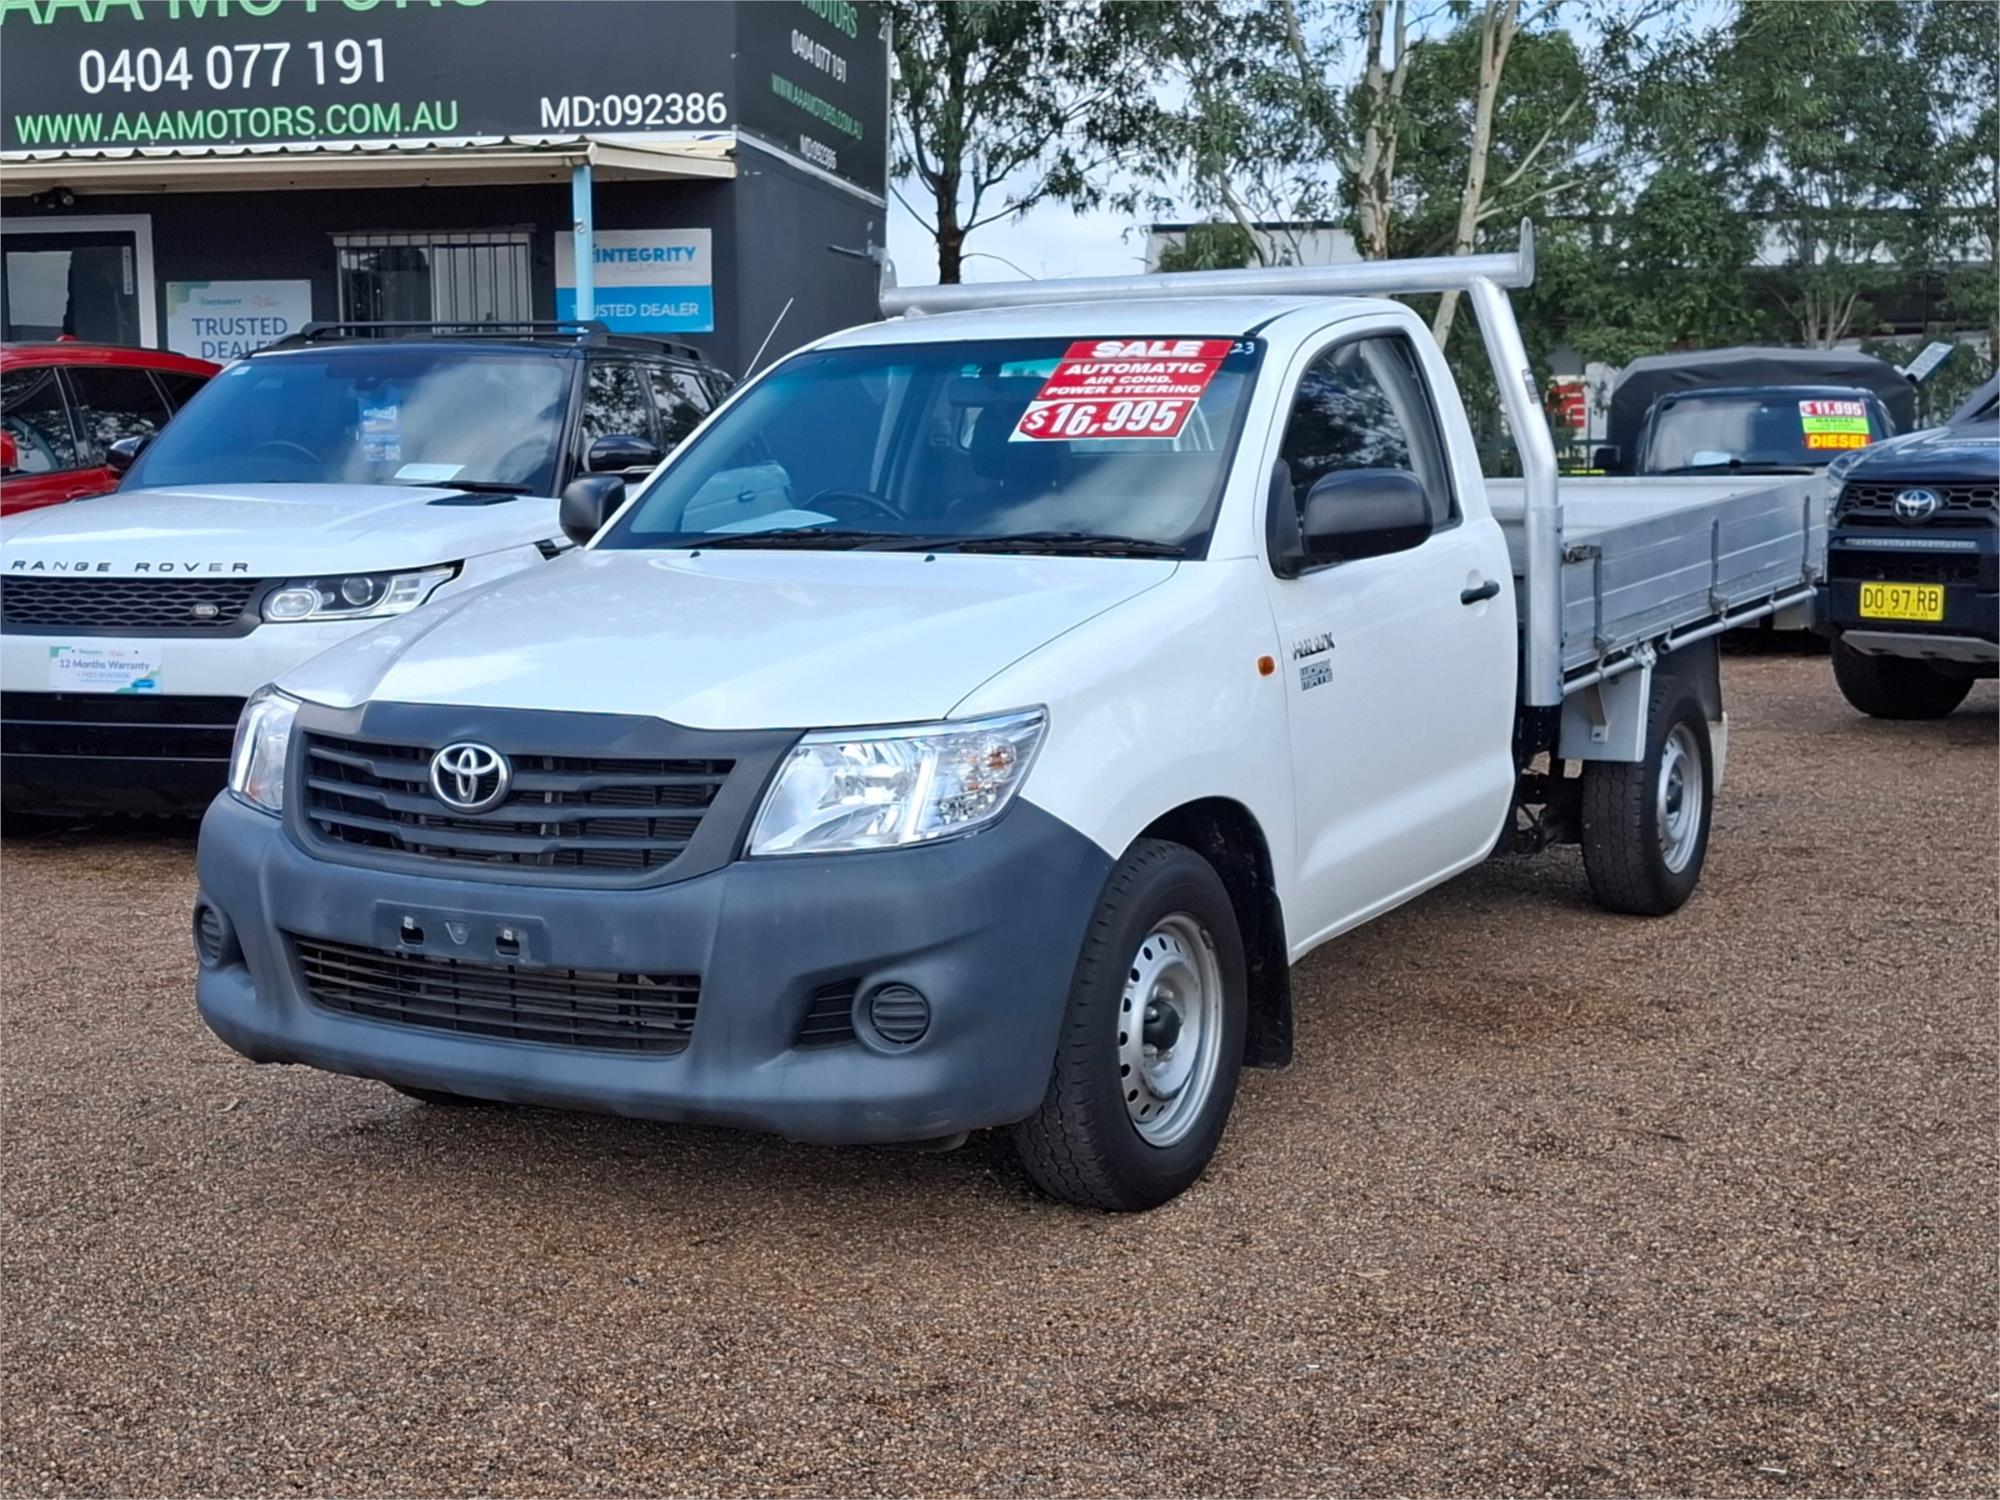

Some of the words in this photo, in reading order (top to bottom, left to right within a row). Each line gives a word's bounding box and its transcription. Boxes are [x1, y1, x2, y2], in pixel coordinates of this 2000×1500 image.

[791, 29, 814, 63] 0404
[815, 43, 831, 73] 077
[832, 54, 846, 83] 191
[79, 47, 193, 94] 0404
[206, 42, 291, 90] 077
[307, 38, 385, 85] 191
[541, 92, 727, 128] MD:092386
[15, 100, 459, 143] WWW.AAAMOTORS.COM.AU
[594, 246, 697, 263] INTEGRITY
[640, 303, 699, 316] DEALER
[191, 317, 288, 336] TRUSTED
[1092, 341, 1205, 358] SALE
[1064, 362, 1207, 376] AUTOMATIC
[1083, 376, 1117, 384] AIR
[1119, 375, 1173, 384] COND.
[1045, 385, 1108, 396] POWER
[1112, 384, 1202, 394] STEERING
[1025, 400, 1184, 436] $16,995
[1809, 434, 1867, 448] DIESEL
[11, 560, 112, 572] RANGE
[135, 562, 250, 573] ROVER
[60, 660, 71, 668] 12
[73, 660, 106, 669] Months
[108, 660, 150, 670] Warranty
